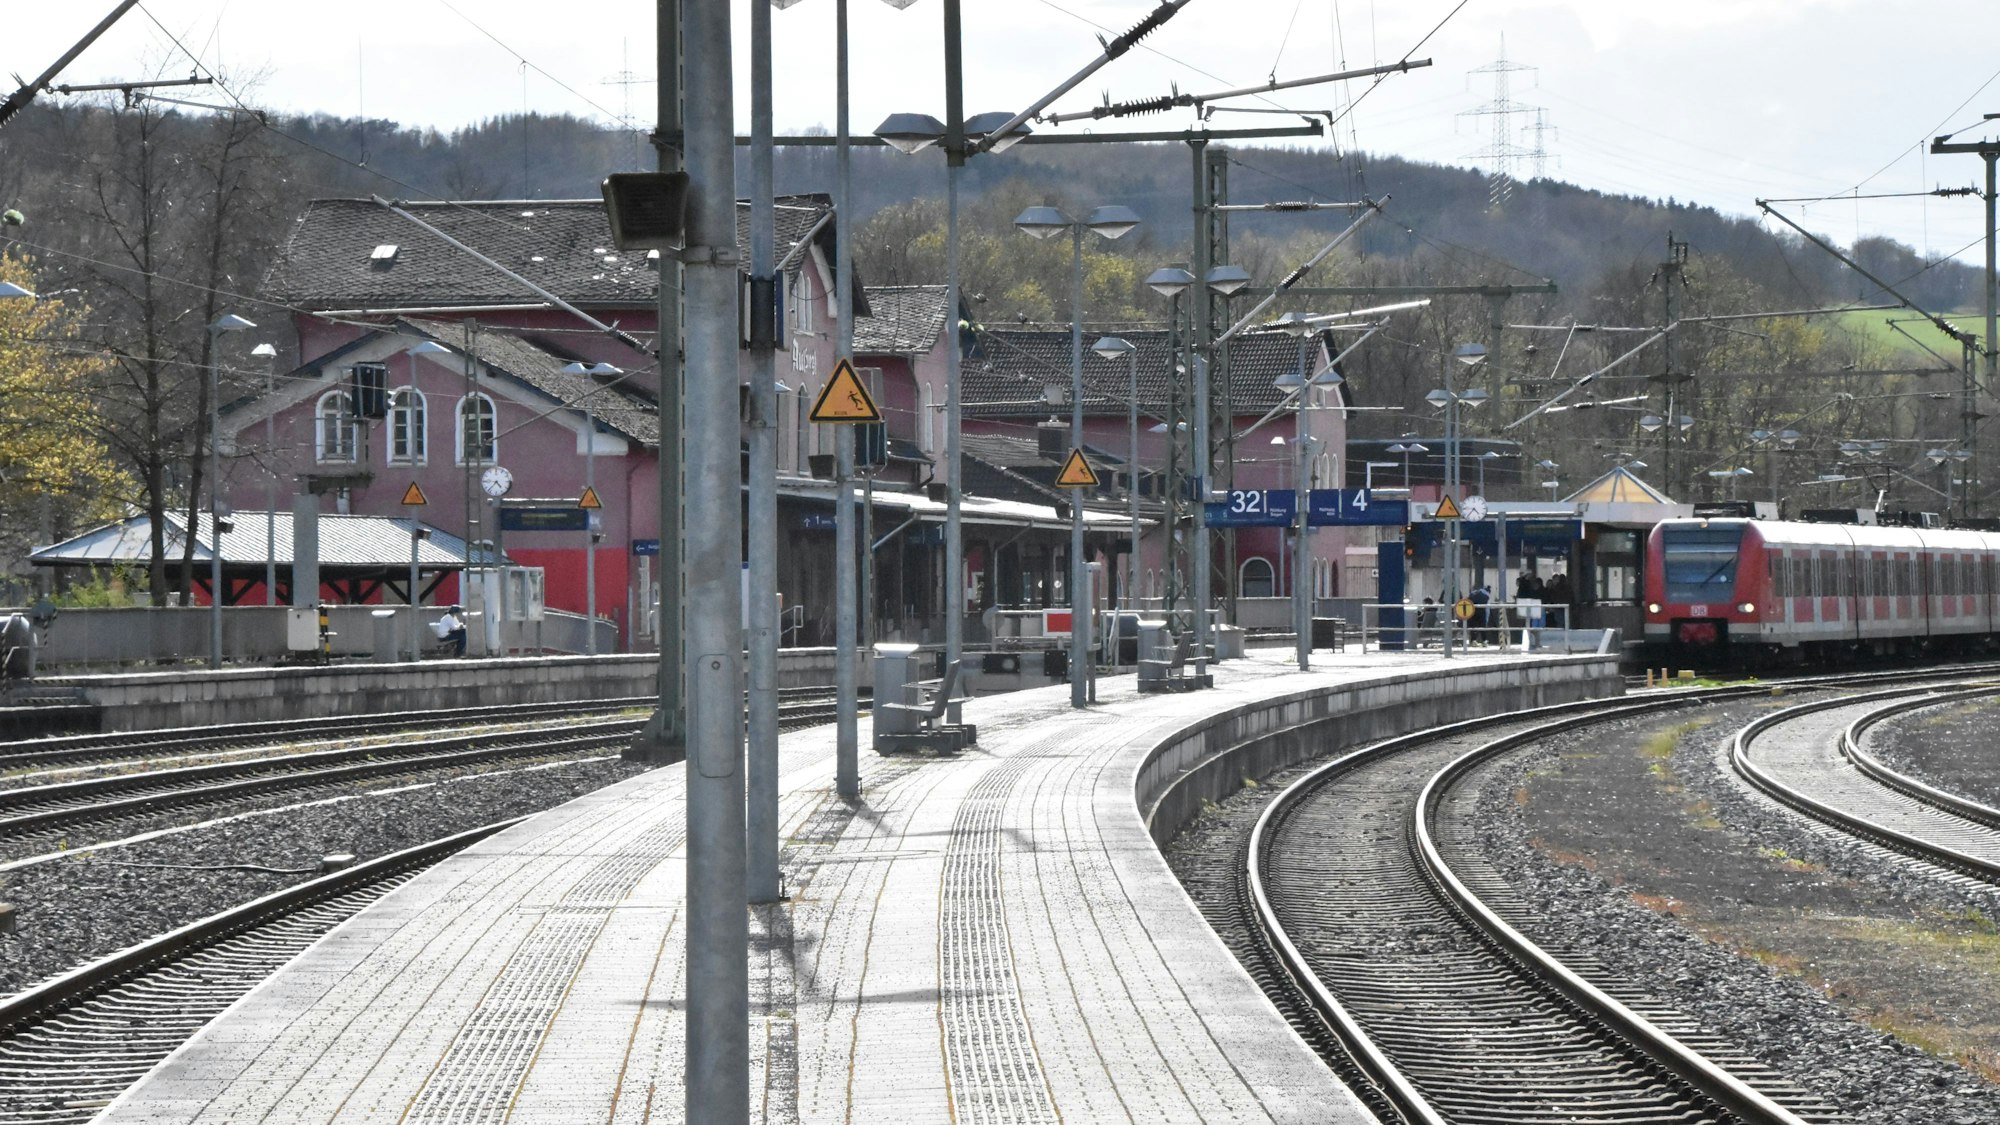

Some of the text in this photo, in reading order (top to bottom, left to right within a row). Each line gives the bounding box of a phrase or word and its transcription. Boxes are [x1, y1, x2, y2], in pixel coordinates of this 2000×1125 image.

[1231, 490, 1260, 513] 32
[1352, 489, 1368, 512] 4
[935, 524, 943, 540] 1
